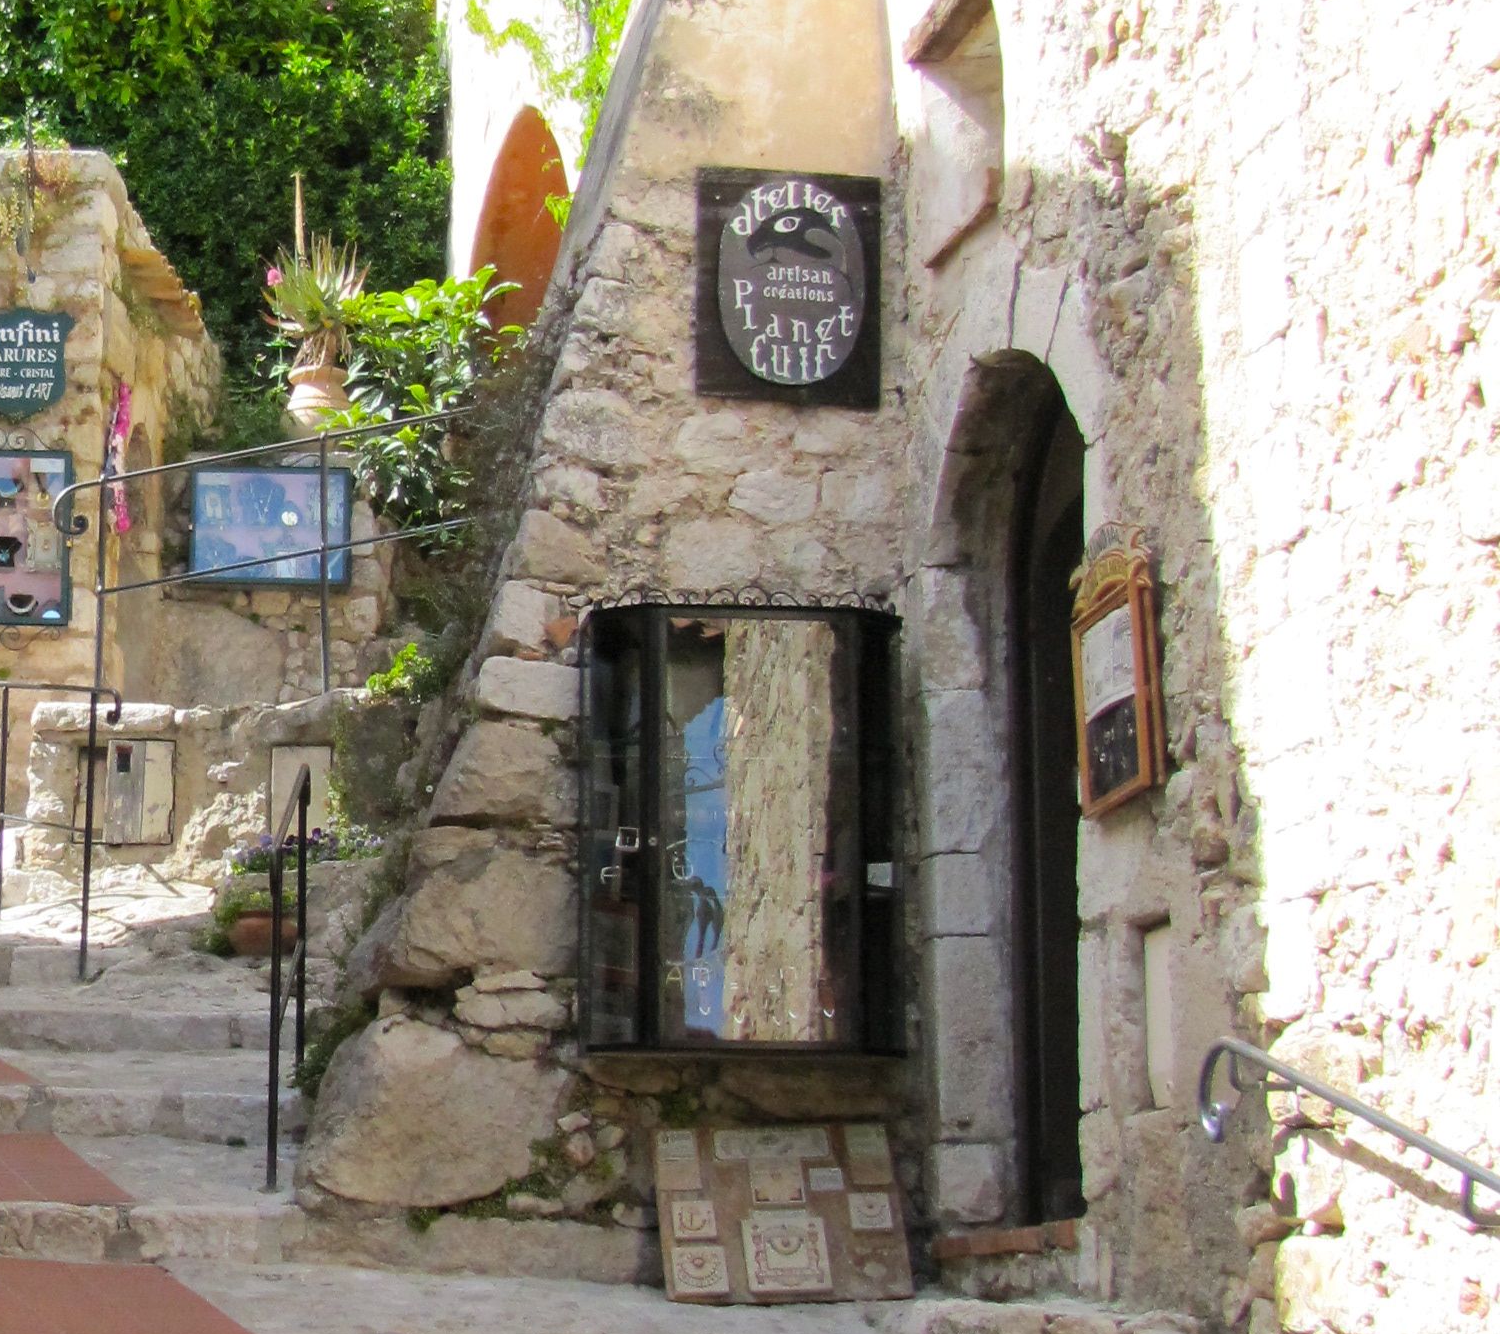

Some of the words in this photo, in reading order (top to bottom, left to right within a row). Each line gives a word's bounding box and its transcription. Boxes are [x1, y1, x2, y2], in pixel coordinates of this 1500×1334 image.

[766, 266, 833, 285] artisan
[762, 282, 835, 303] créations
[732, 278, 854, 344] Planet
[749, 333, 837, 379] Cuir
[20, 368, 56, 379] CRISTAL
